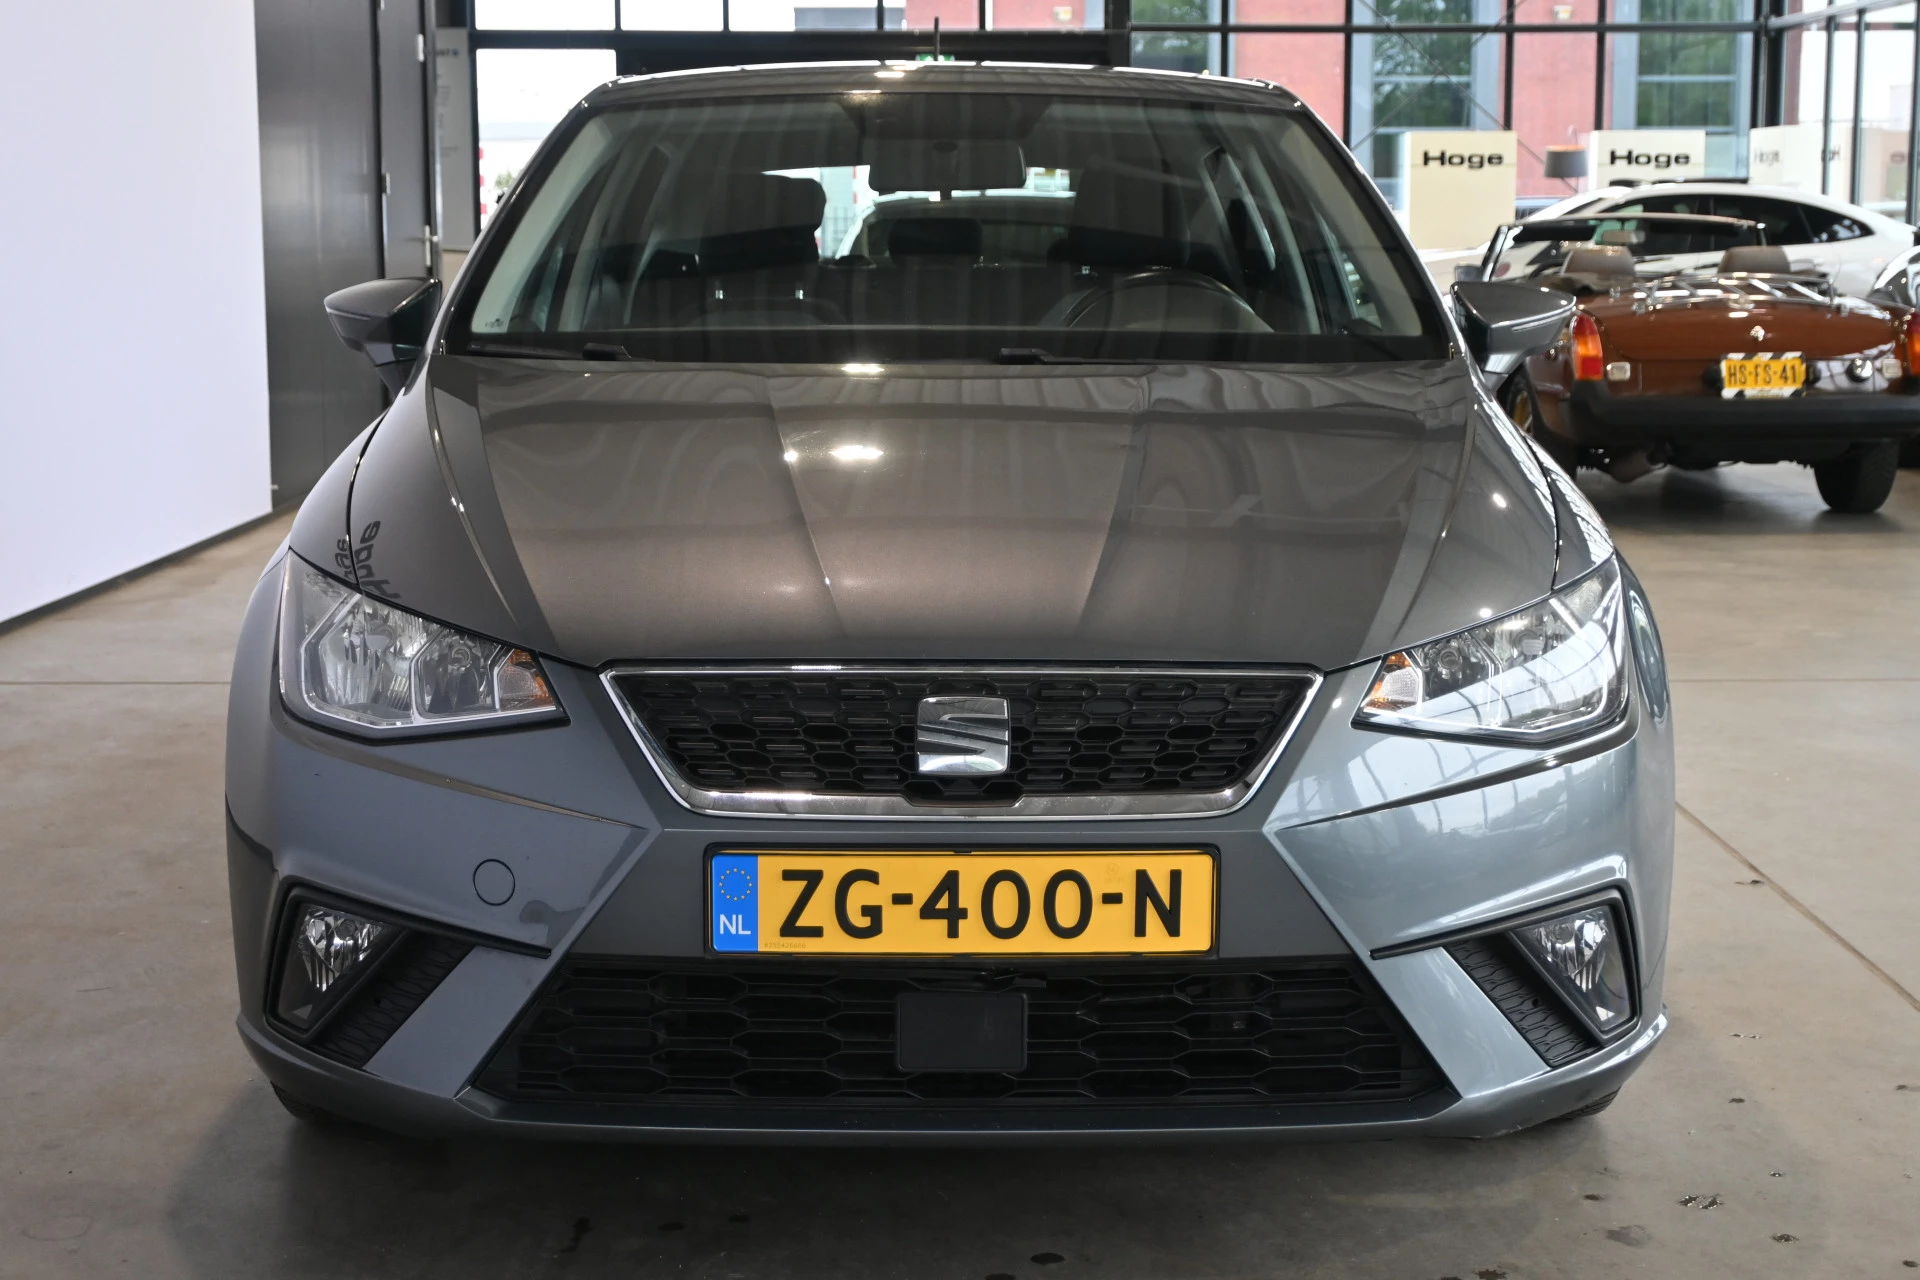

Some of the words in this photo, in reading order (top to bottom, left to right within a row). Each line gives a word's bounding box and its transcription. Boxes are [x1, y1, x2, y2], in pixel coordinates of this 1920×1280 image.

[1423, 150, 1504, 169] Hoge
[1610, 150, 1690, 168] Hoge
[1727, 363, 1797, 386] HS-FS-41
[780, 868, 1182, 939] ZG-400-N
[720, 913, 752, 935] NL
